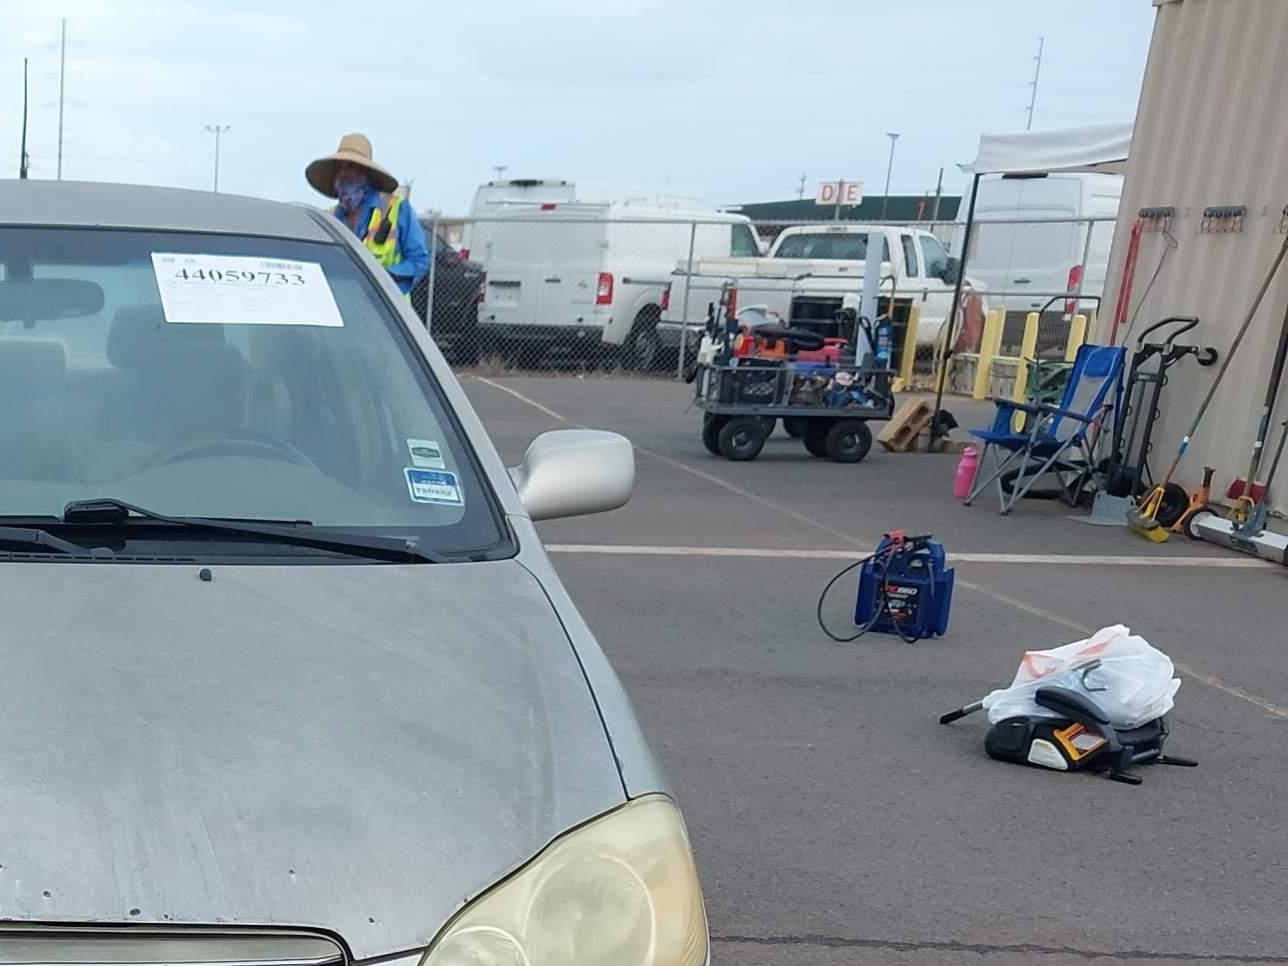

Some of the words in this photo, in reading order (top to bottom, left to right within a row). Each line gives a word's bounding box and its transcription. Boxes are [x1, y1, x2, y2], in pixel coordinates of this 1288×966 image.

[822, 185, 833, 201] D
[847, 185, 858, 201] E
[174, 267, 306, 286] 44059733
